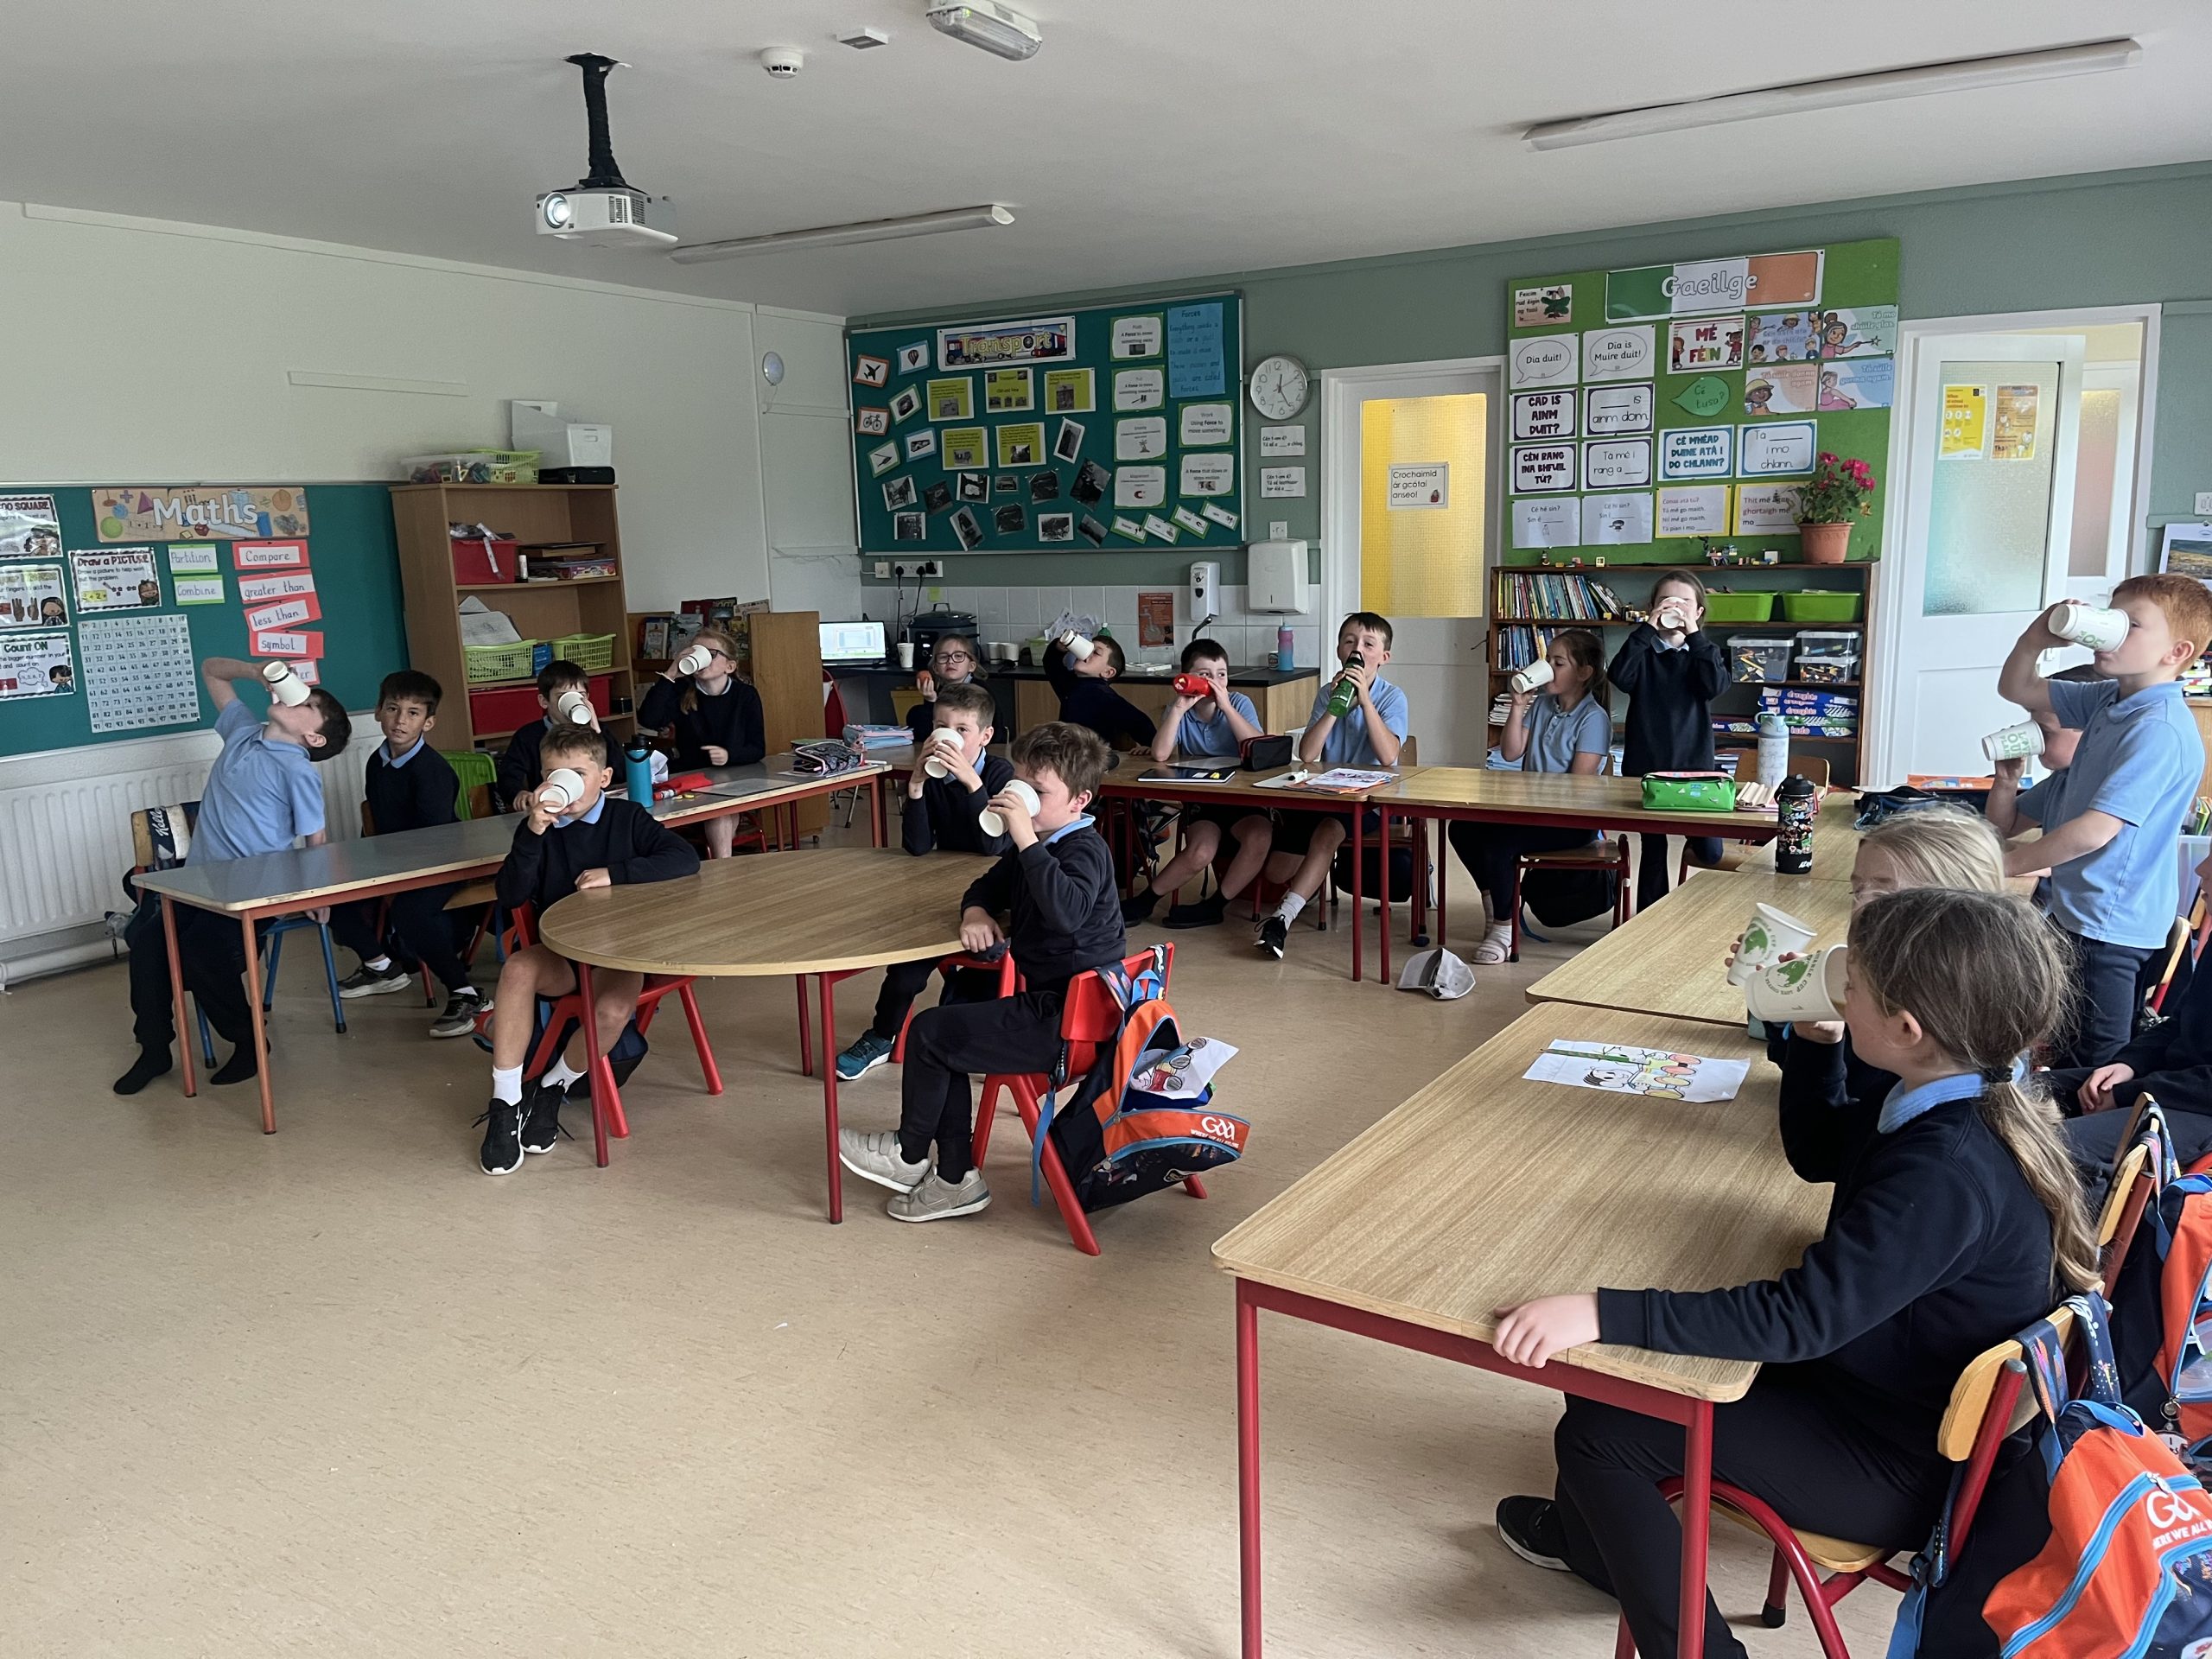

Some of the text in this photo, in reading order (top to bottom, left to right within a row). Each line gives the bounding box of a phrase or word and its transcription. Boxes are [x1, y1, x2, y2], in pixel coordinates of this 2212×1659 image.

[1661, 270, 1758, 300] Gaeilge
[1695, 323, 1717, 341] MÉ
[960, 332, 1052, 359] Transport
[1607, 341, 1622, 350] Dia
[1542, 353, 1562, 363] duit!
[1594, 349, 1642, 361] Muire duit!
[1689, 346, 1721, 363] FÉIN
[1529, 395, 1561, 406] CAD IS
[1633, 395, 1642, 404] is
[1531, 410, 1558, 421] AINM
[1592, 413, 1618, 423] ainm
[1529, 423, 1560, 435] DUIT?
[1675, 434, 1719, 445] CÉ MHÉAD
[1615, 449, 1630, 460] mé
[1671, 447, 1697, 457] DUINE
[1700, 445, 1717, 455] ATÁ
[1771, 445, 1789, 454] mo
[1522, 451, 1565, 462] CÉN RANG
[1522, 462, 1566, 474] INA BHFUIL
[1669, 458, 1725, 469] DO CHLANN?
[1392, 470, 1437, 479] Crochaimid
[1593, 467, 1614, 476] rang
[1535, 474, 1553, 484] TÚ?
[15, 501, 50, 512] SQUARE
[152, 493, 258, 526] Maths
[77, 557, 101, 567] Draw
[111, 554, 149, 565] PICTURE
[171, 551, 212, 564] Partition
[245, 550, 290, 564] Compare
[177, 584, 217, 597] Combine
[245, 581, 305, 601] greater than
[252, 608, 299, 627] less than
[4, 641, 48, 653] Count ON
[261, 638, 296, 652] symbol
[1790, 726, 1811, 735] ludo
